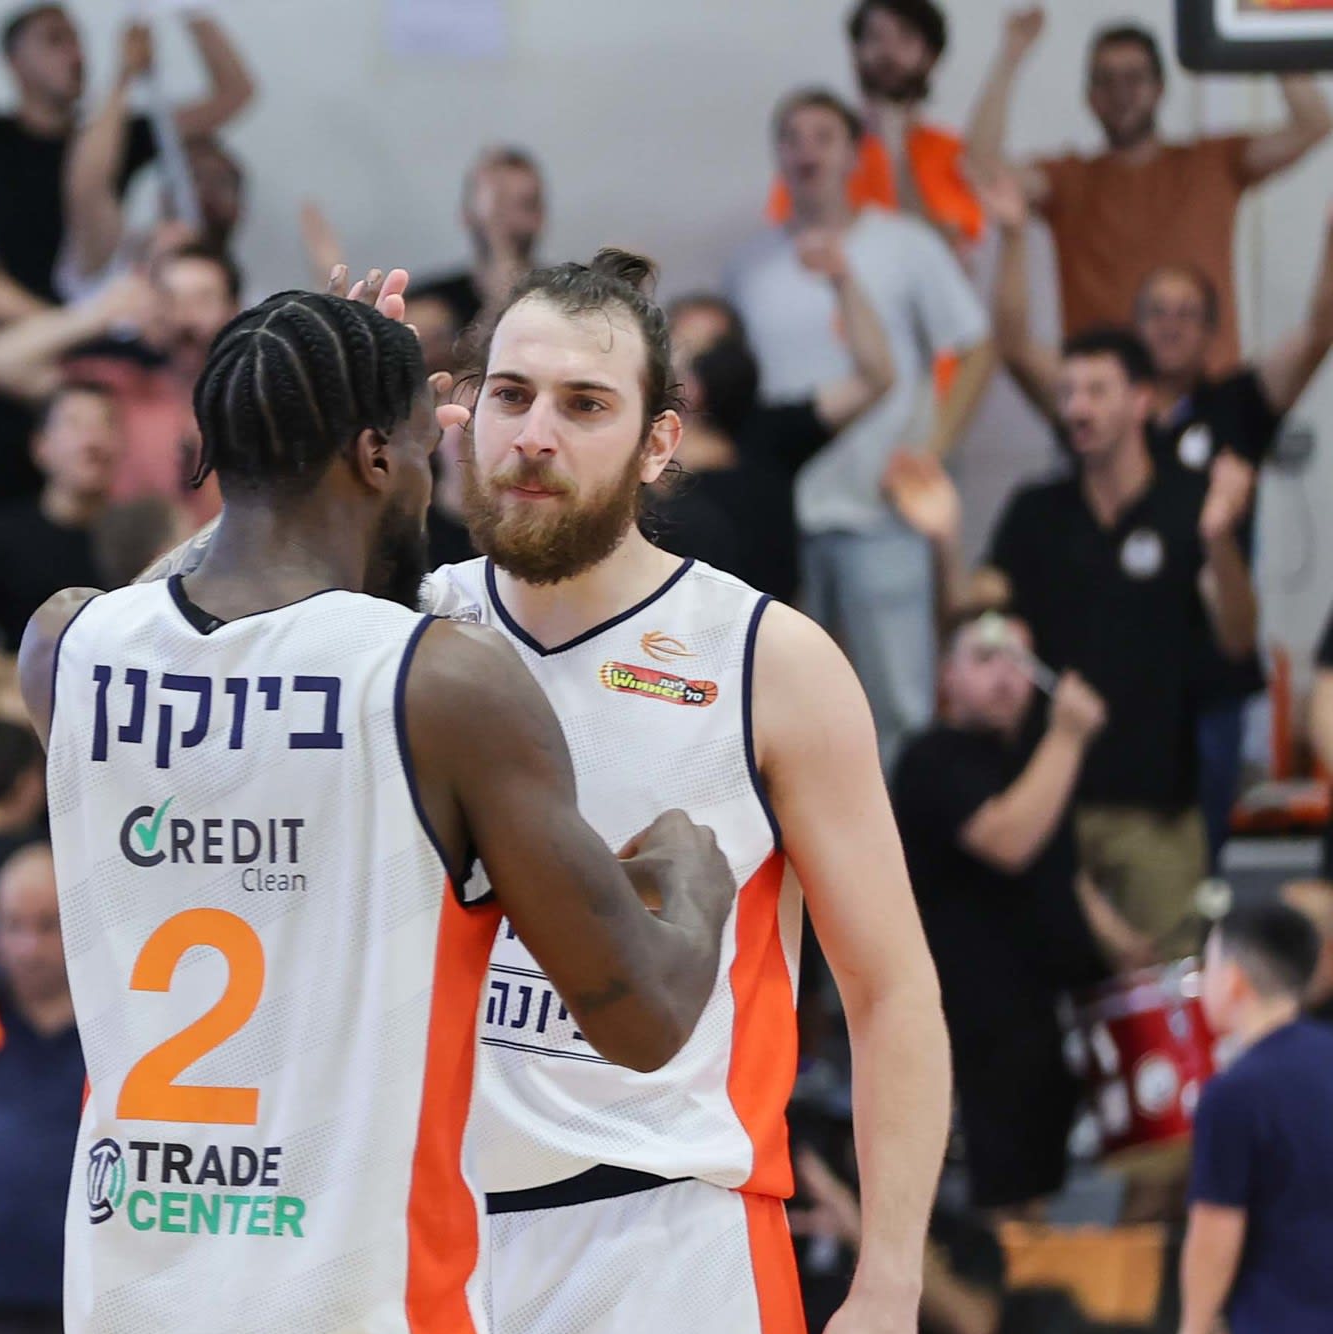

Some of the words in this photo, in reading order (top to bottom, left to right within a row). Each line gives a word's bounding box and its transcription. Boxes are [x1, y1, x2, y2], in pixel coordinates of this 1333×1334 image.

[92, 665, 343, 768] ביוקנן
[120, 804, 305, 868] CREDIT
[241, 868, 307, 892] Clean
[116, 908, 265, 1125] 2
[486, 981, 583, 1040] יונה
[129, 1141, 282, 1186] TRADE
[127, 1190, 306, 1237] CENTER
